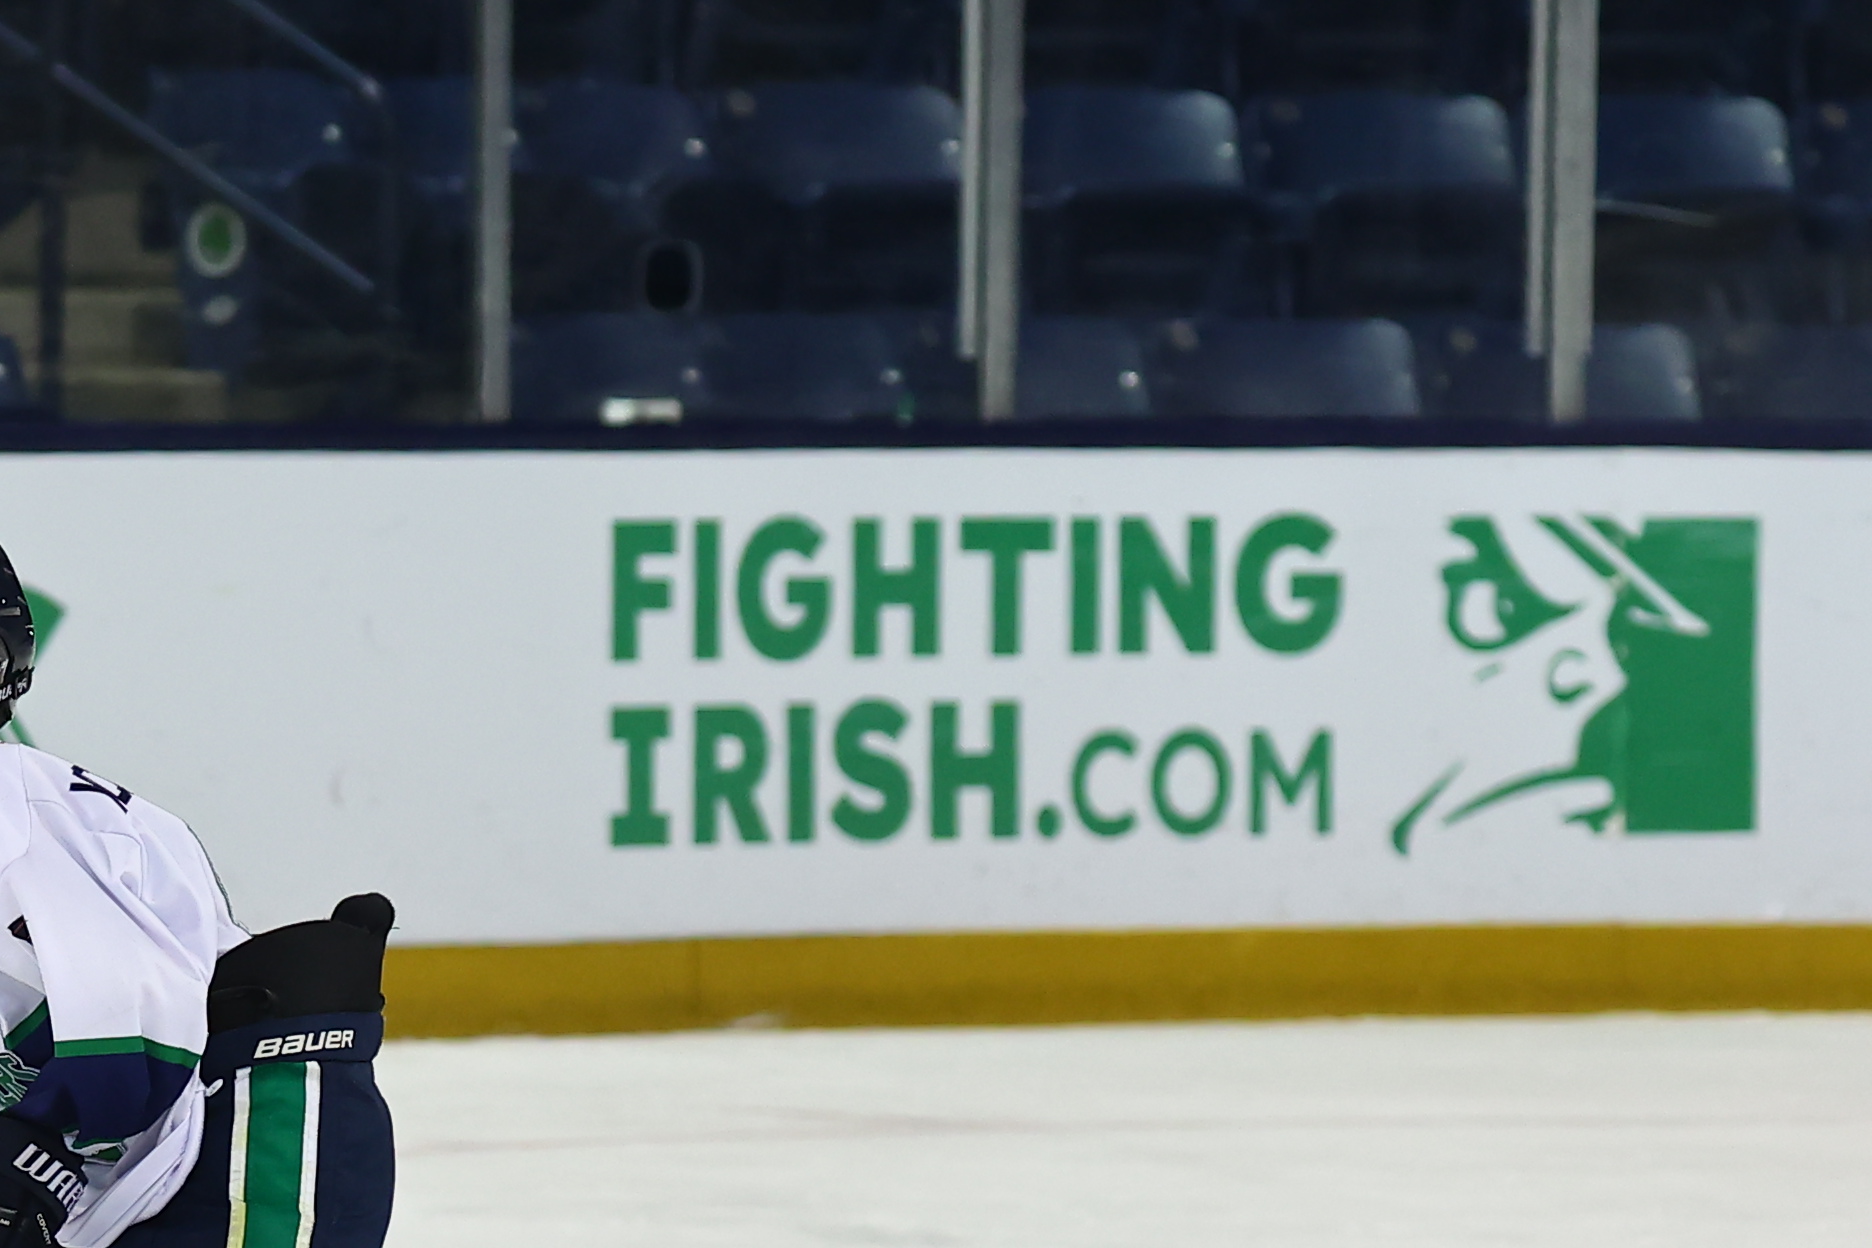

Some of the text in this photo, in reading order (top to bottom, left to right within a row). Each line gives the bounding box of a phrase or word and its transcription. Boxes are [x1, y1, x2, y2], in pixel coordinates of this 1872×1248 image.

[610, 512, 1342, 662] FIGHTING
[610, 698, 1333, 847] IRISH.COM
[253, 1029, 355, 1059] BAUER
[36, 1213, 52, 1245] COVERT
